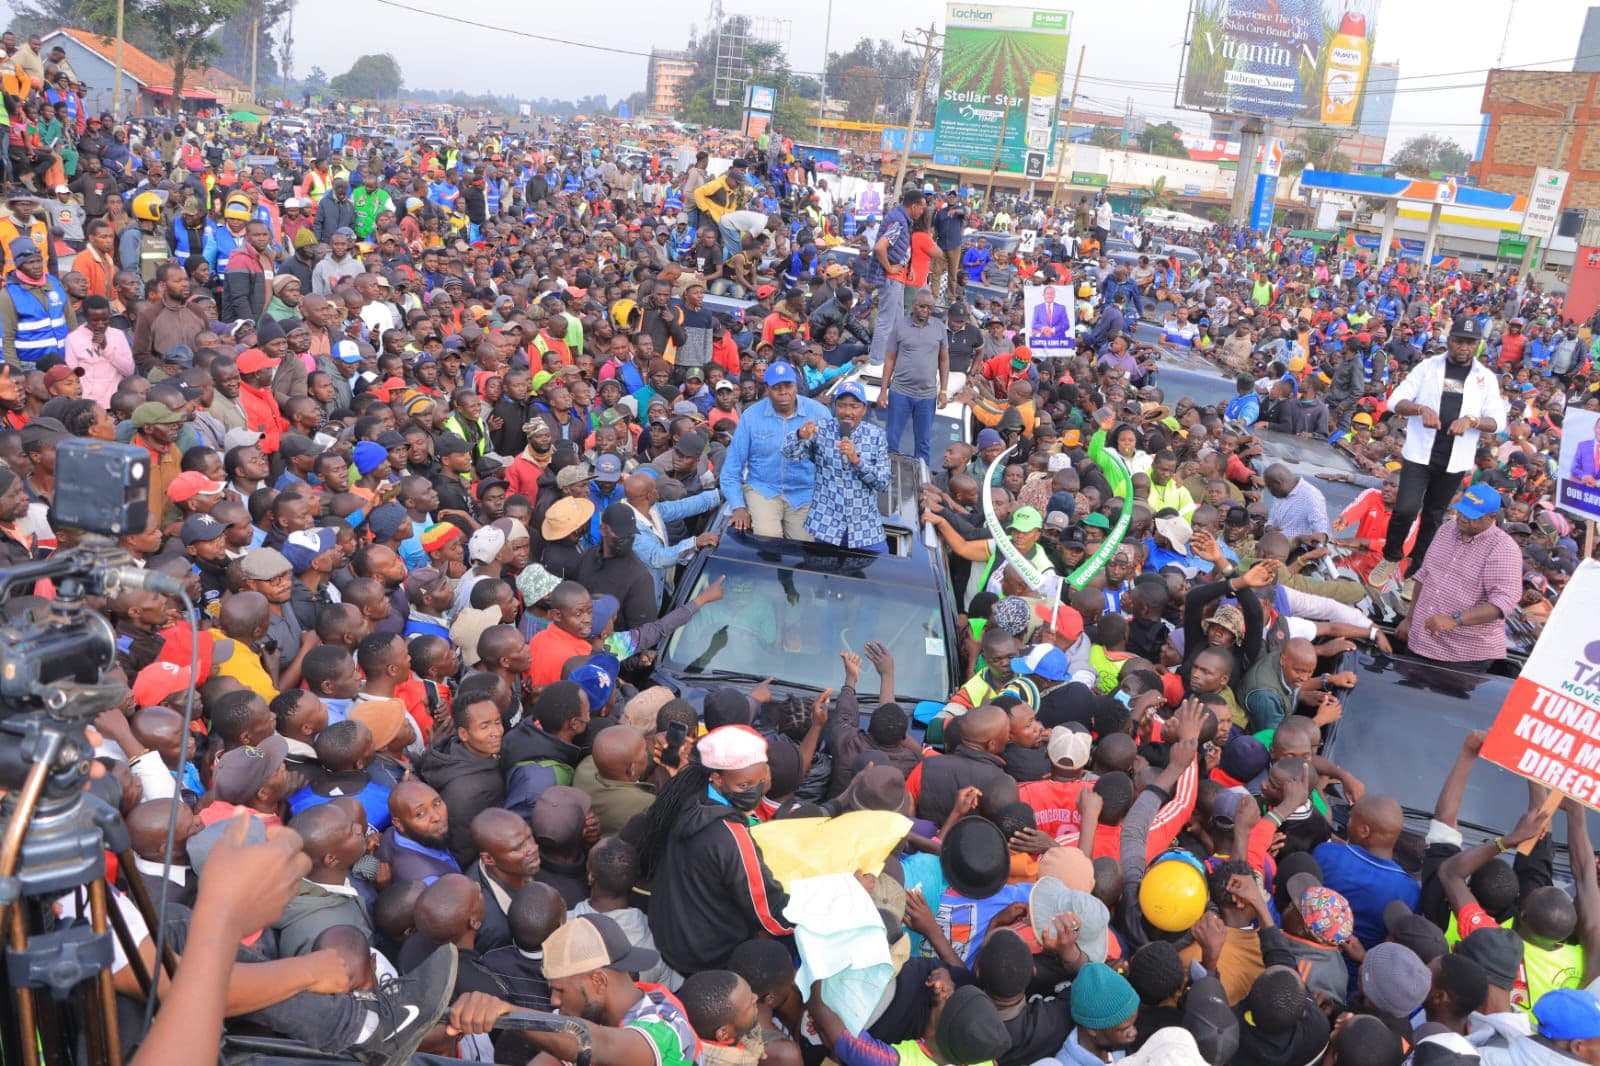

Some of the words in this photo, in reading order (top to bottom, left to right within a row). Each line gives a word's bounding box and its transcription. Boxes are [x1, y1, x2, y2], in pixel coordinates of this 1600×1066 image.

[952, 8, 992, 20] Lachlan
[1229, 7, 1273, 21] Experience
[1275, 13, 1290, 24] The
[1290, 16, 1310, 27] Only
[1226, 20, 1245, 31] Skin
[1246, 23, 1265, 34] Care
[1266, 26, 1290, 38] Brand
[1204, 31, 1291, 67] Vitamin
[1296, 43, 1326, 72] N
[1225, 72, 1263, 85] Embrace
[1265, 78, 1293, 90] Nature
[944, 89, 988, 103] Stellar
[995, 94, 1024, 106] Star
[1566, 486, 1582, 500] OUR
[1076, 557, 1103, 585] GEORGE
[1513, 713, 1576, 759] KWA
